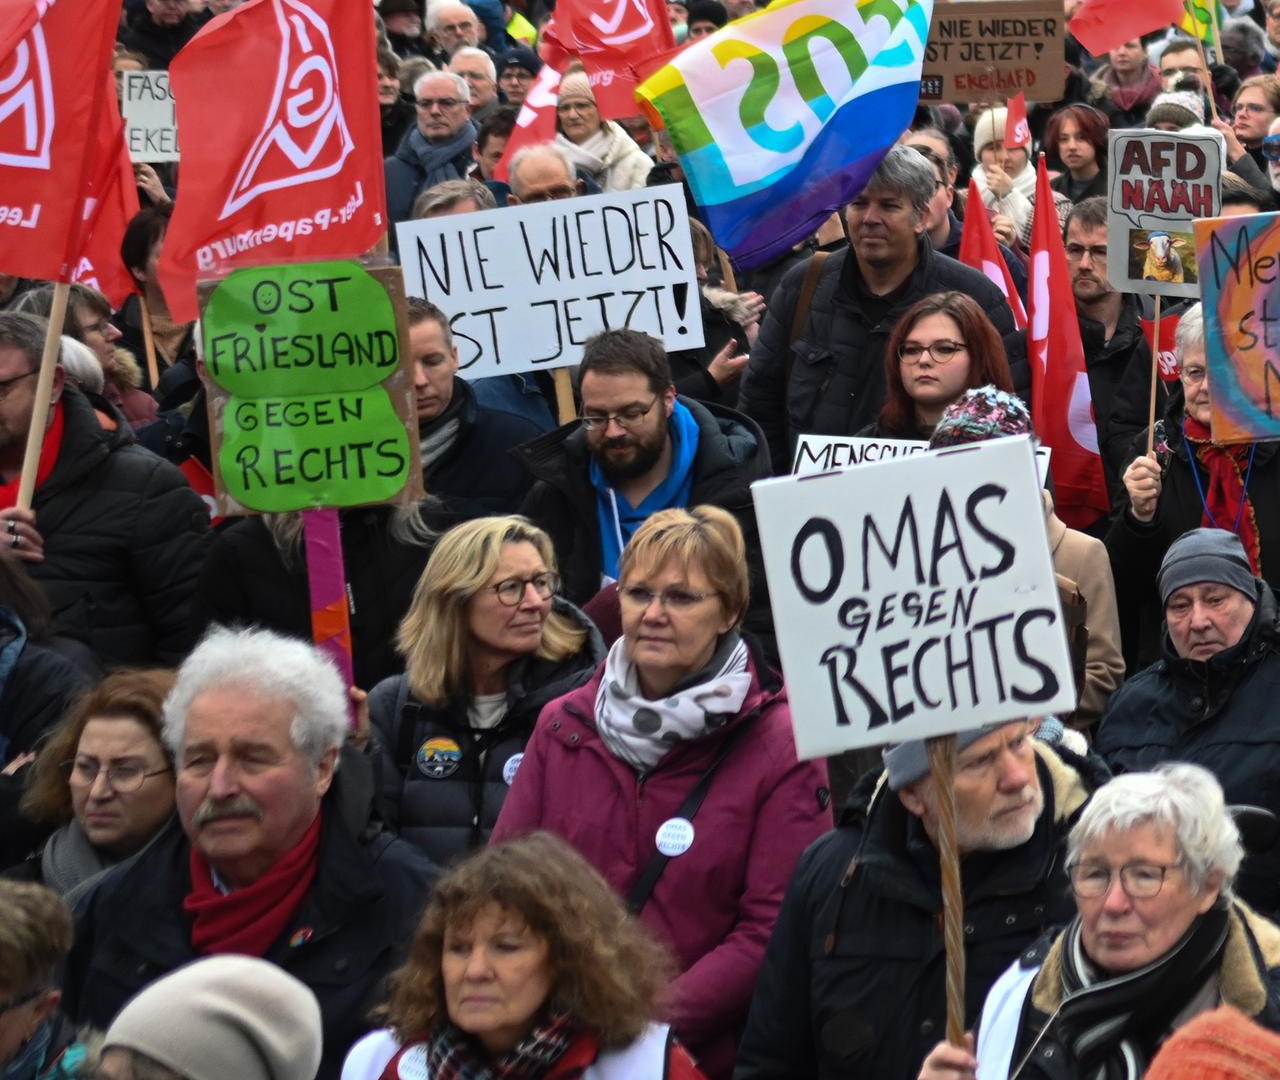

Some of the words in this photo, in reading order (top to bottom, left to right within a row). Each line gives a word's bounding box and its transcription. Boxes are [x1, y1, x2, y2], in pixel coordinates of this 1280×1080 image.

[926, 42, 950, 62] ST
[939, 21, 972, 38] NIE
[979, 19, 1056, 38] WIEDER
[1121, 140, 1206, 180] AFD
[417, 226, 503, 298] NIE
[520, 199, 683, 286] WIEDER
[252, 277, 351, 315] OST
[449, 308, 507, 370] ST
[531, 283, 688, 365] JETZT!
[235, 398, 363, 432] GEGEN
[236, 440, 405, 490] RECHTS
[790, 483, 1016, 605] OMAS
[837, 587, 979, 647] GEGEN
[819, 608, 1060, 731] RECHTS
